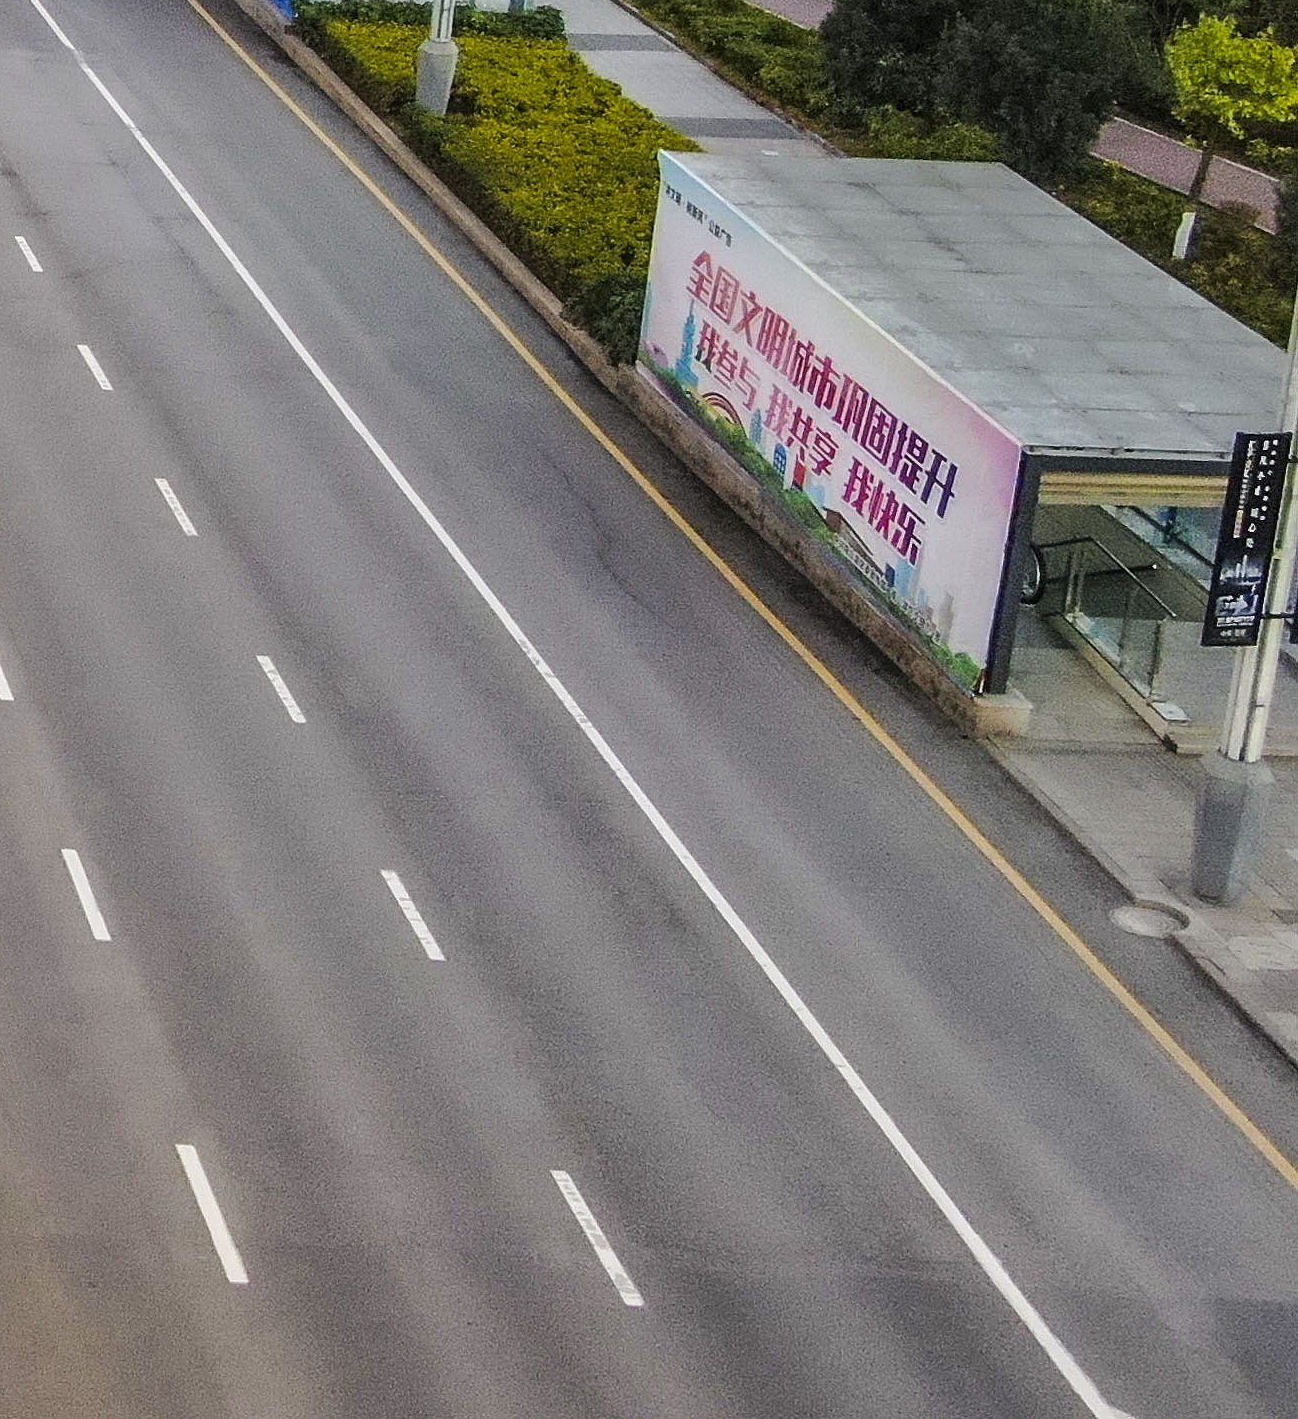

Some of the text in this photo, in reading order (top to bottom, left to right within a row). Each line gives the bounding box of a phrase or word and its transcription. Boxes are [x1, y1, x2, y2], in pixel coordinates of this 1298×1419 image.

[686, 249, 958, 520] 全国文明城市巩固提升
[695, 319, 926, 566] 我参与 我共享 我快乐
